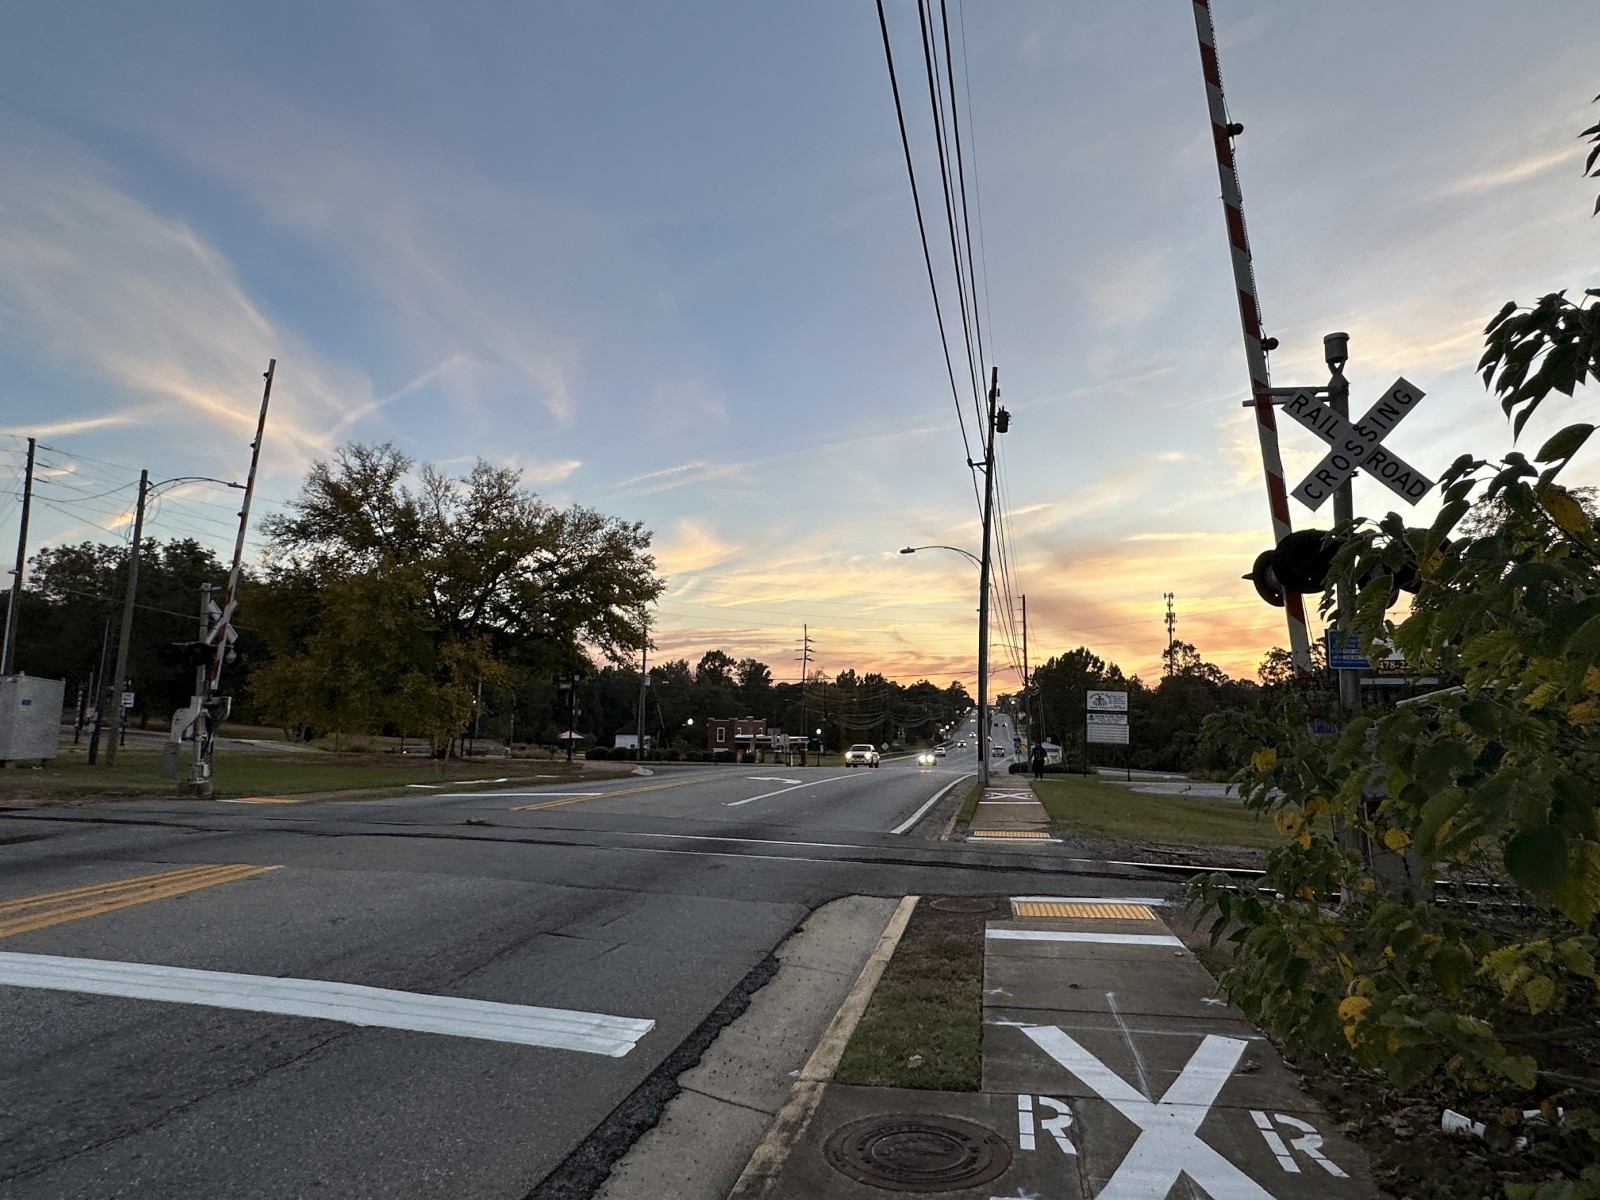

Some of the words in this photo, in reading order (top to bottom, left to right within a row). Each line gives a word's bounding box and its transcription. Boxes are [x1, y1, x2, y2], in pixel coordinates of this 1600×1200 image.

[1288, 393, 1340, 440] RAIL
[1366, 450, 1426, 498] ROAD
[1303, 388, 1413, 500] CROSSING
